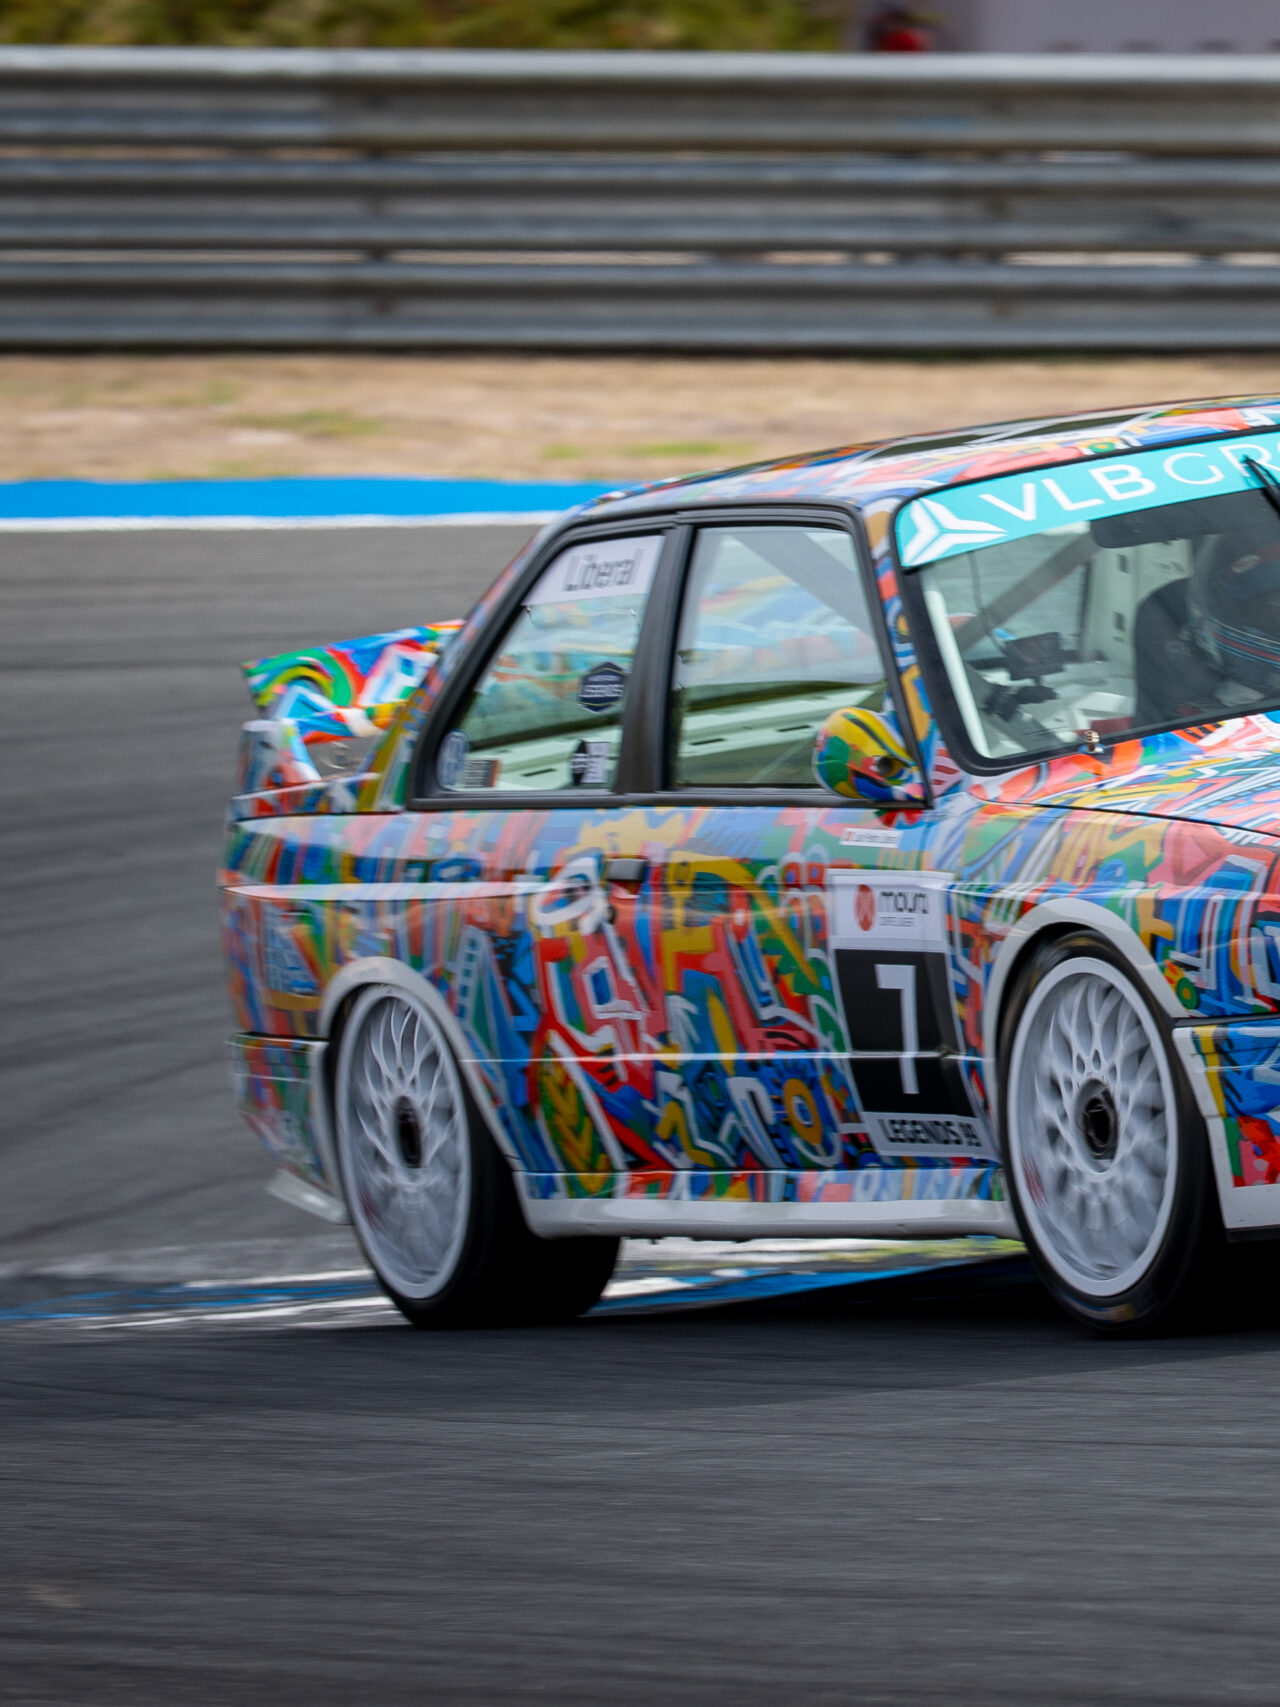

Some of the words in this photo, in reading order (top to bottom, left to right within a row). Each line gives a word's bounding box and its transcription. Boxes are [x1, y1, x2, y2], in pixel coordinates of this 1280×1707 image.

[977, 463, 1158, 522] VLB
[874, 964, 920, 1094] 7
[878, 1118, 964, 1146] LEGENDS
